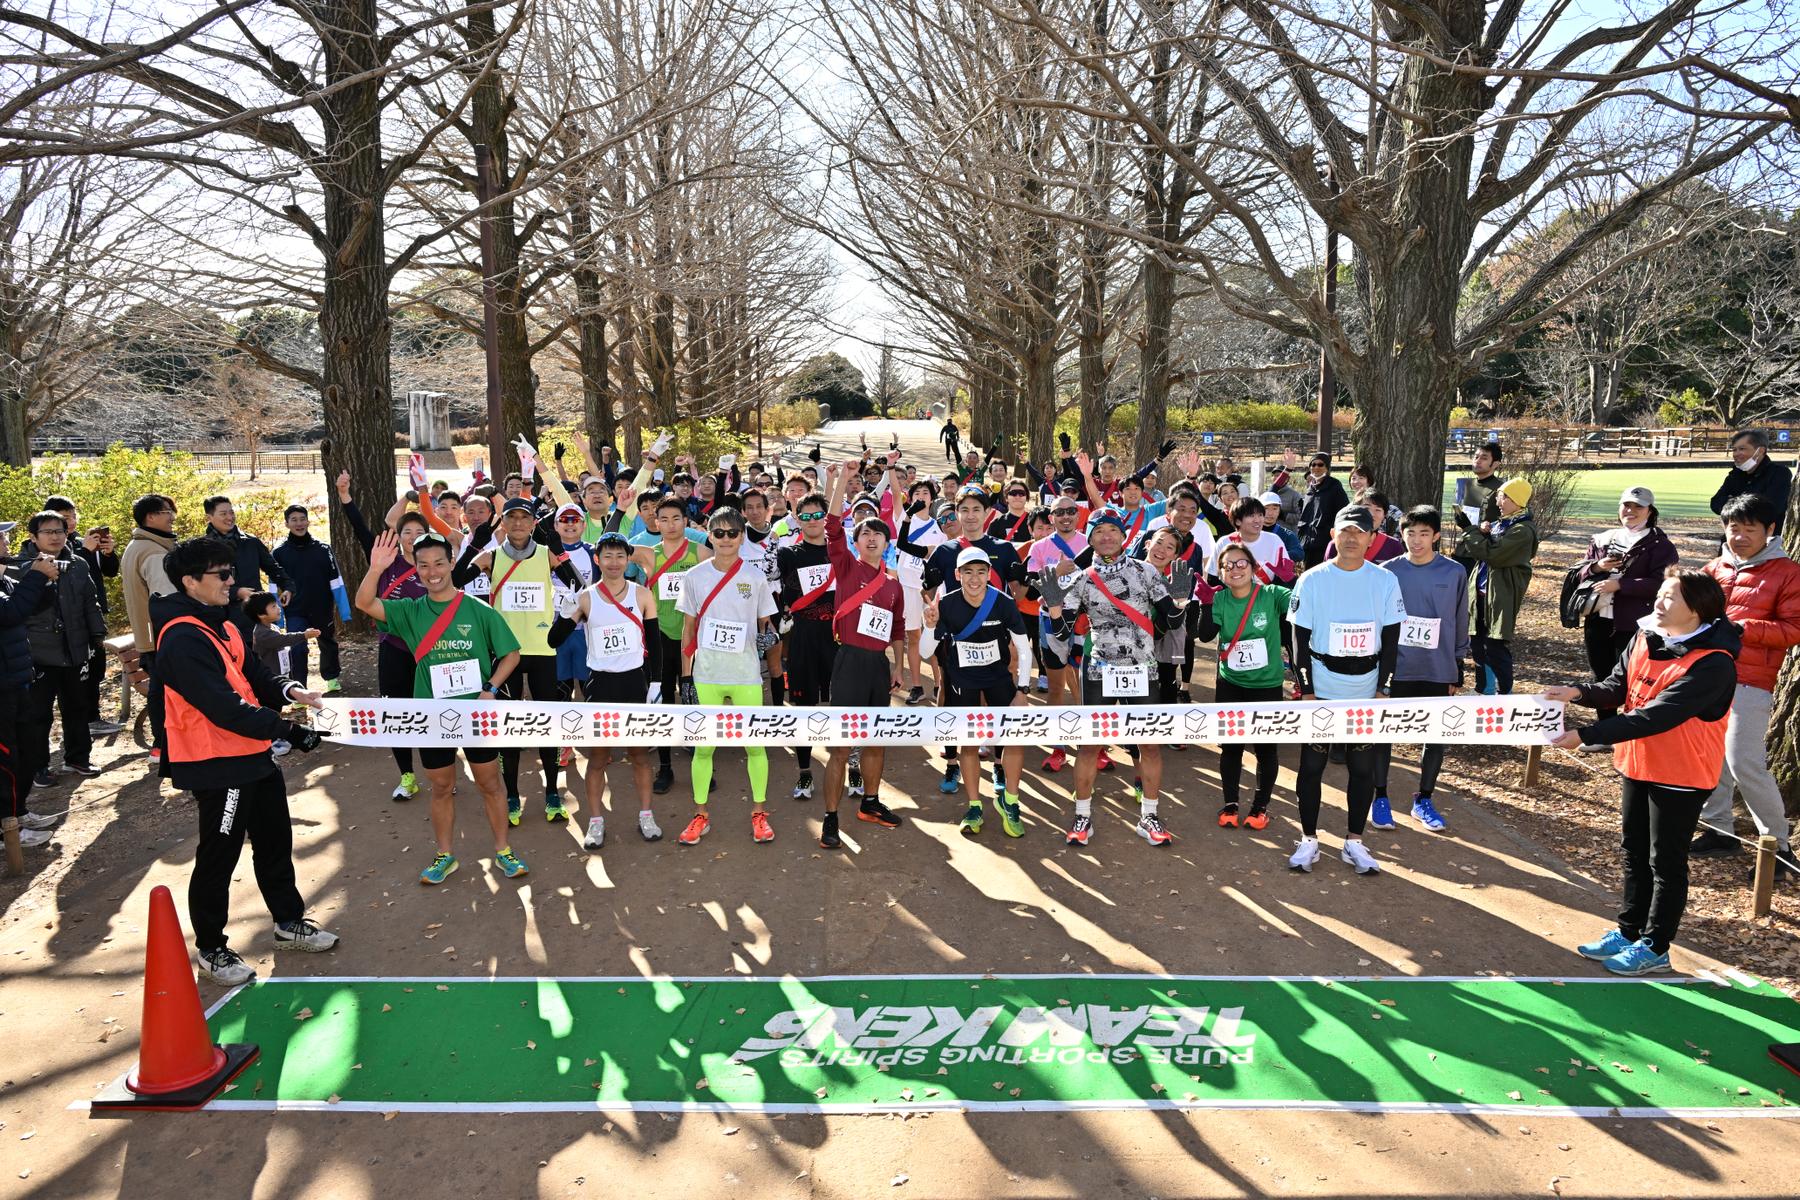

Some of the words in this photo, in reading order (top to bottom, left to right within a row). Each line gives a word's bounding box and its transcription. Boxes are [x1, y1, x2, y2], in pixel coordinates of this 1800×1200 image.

[1204, 435, 1213, 444] B
[1489, 433, 1498, 441] B
[1779, 432, 1788, 441] C
[514, 591, 535, 604] 15-1
[868, 616, 888, 633] 47-2
[713, 629, 736, 644] 13-5
[1407, 626, 1431, 641] 216
[603, 634, 628, 650] 20-1
[1343, 634, 1366, 649] 102
[964, 649, 993, 660] 301-1
[1237, 651, 1253, 664] 2-1
[449, 674, 464, 688] 1-1
[1115, 676, 1137, 689] 19-1
[381, 711, 428, 724] トーシン
[503, 712, 552, 726] トーシン
[625, 713, 674, 727] トーシン
[748, 713, 798, 727] トーシン
[873, 714, 923, 727] トーシン
[999, 713, 1049, 727] トーシン
[1125, 712, 1174, 726] トーシン
[1251, 710, 1301, 725] トーシン
[1379, 709, 1430, 723] トーシン
[1509, 707, 1562, 721] トーシン
[382, 725, 430, 736] パートナーズ
[503, 726, 552, 737] パートナーズ
[625, 727, 674, 738] パートナーズ
[748, 728, 798, 738] パートナーズ
[873, 729, 922, 738] パートナーズ
[999, 728, 1050, 738] パートナーズ
[1125, 726, 1175, 737] パートナーズ
[1251, 725, 1302, 736] パートナーズ
[1379, 724, 1430, 734] パートナーズ
[1508, 722, 1561, 732] パートナーズ
[995, 1004, 1256, 1048] TEAM
[725, 1003, 1004, 1065] KENS
[780, 1048, 925, 1068] SPIRITS
[932, 1046, 1135, 1064] SPORTING
[1149, 1046, 1254, 1064] PURE
